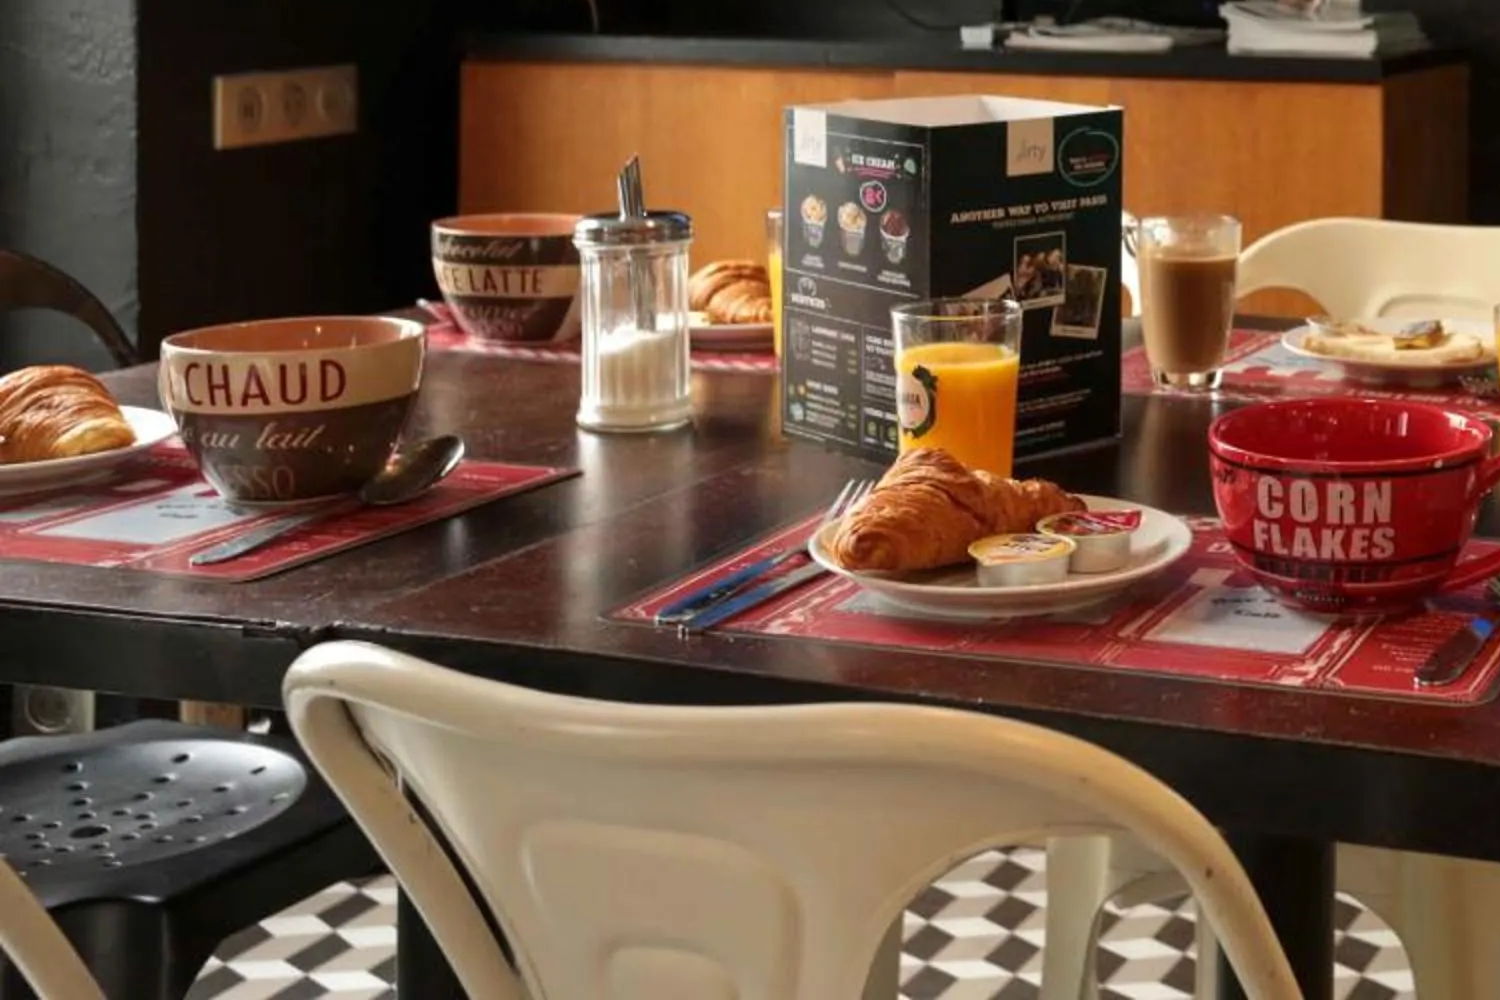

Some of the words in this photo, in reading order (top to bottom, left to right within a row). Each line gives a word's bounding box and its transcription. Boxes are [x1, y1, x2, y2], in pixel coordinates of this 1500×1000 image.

[1033, 203, 1049, 214] TO
[467, 267, 543, 295] LATTE
[184, 359, 347, 408] CHAUD
[200, 429, 241, 449] au
[1256, 475, 1393, 525] CORN
[1252, 518, 1396, 561] FLAKES
